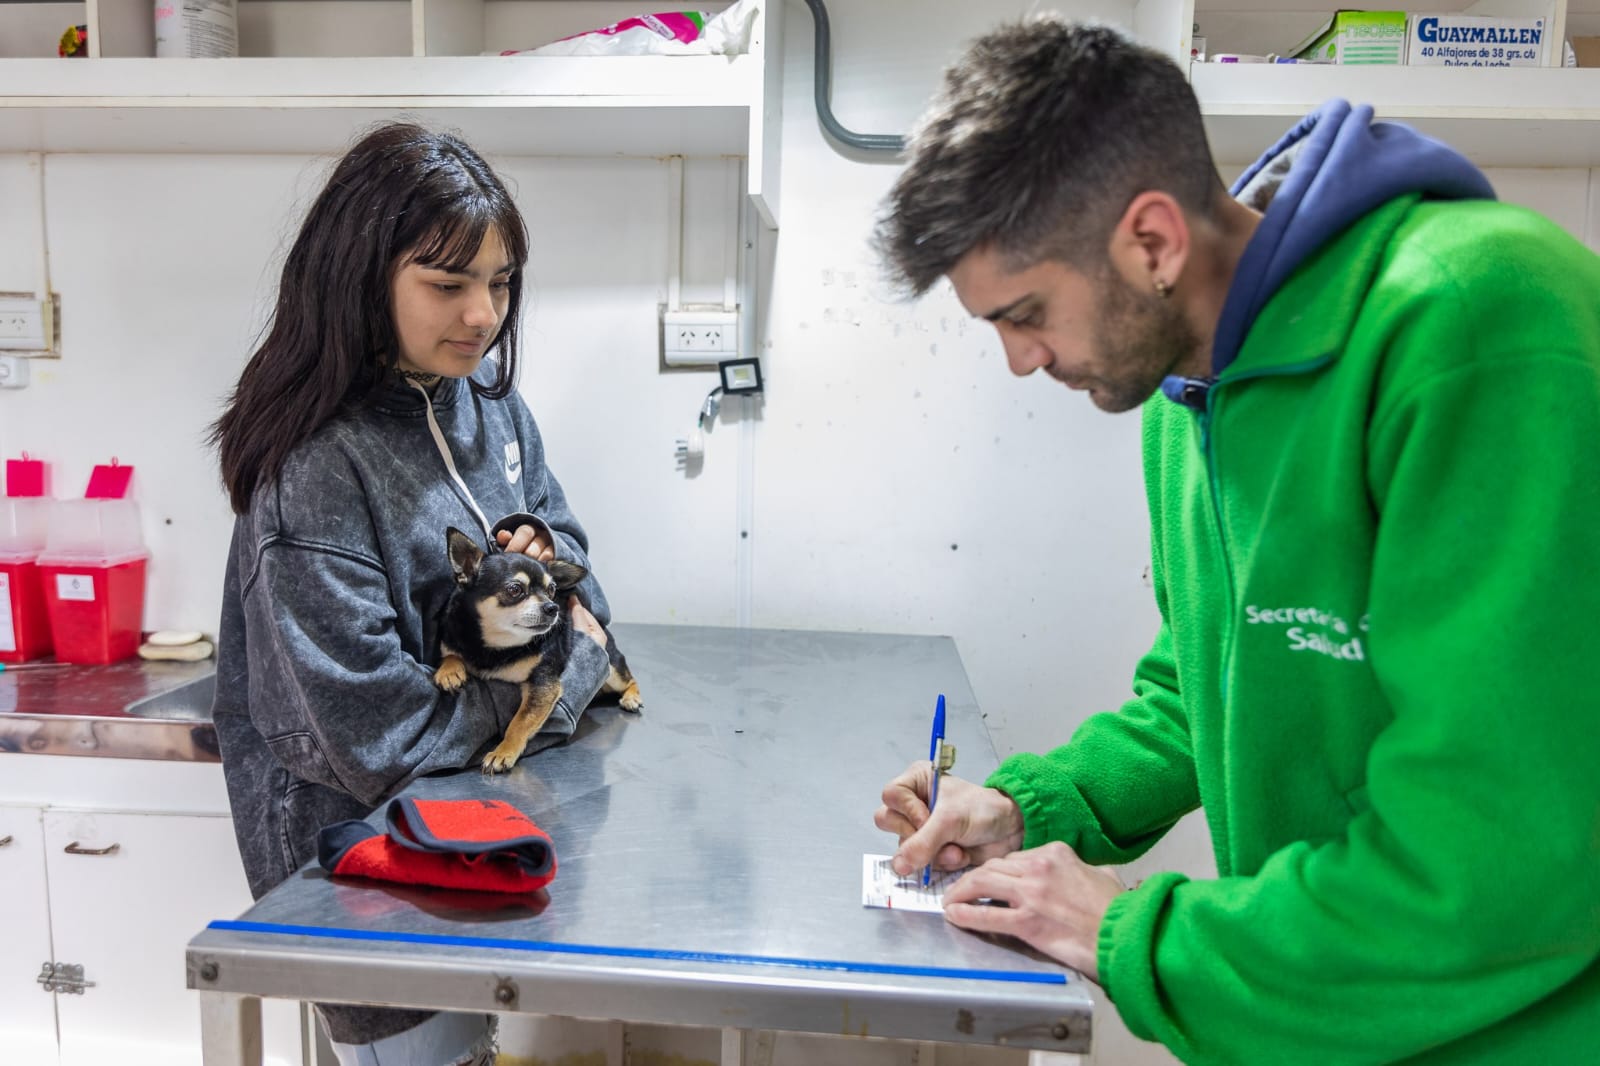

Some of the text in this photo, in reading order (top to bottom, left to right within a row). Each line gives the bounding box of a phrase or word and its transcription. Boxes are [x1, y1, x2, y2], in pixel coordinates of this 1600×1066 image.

[1421, 47, 1434, 57] 40
[1437, 47, 1477, 59] Alfajores
[1478, 48, 1490, 58] de
[1492, 48, 1504, 58] 38
[1507, 50, 1522, 60] grs.
